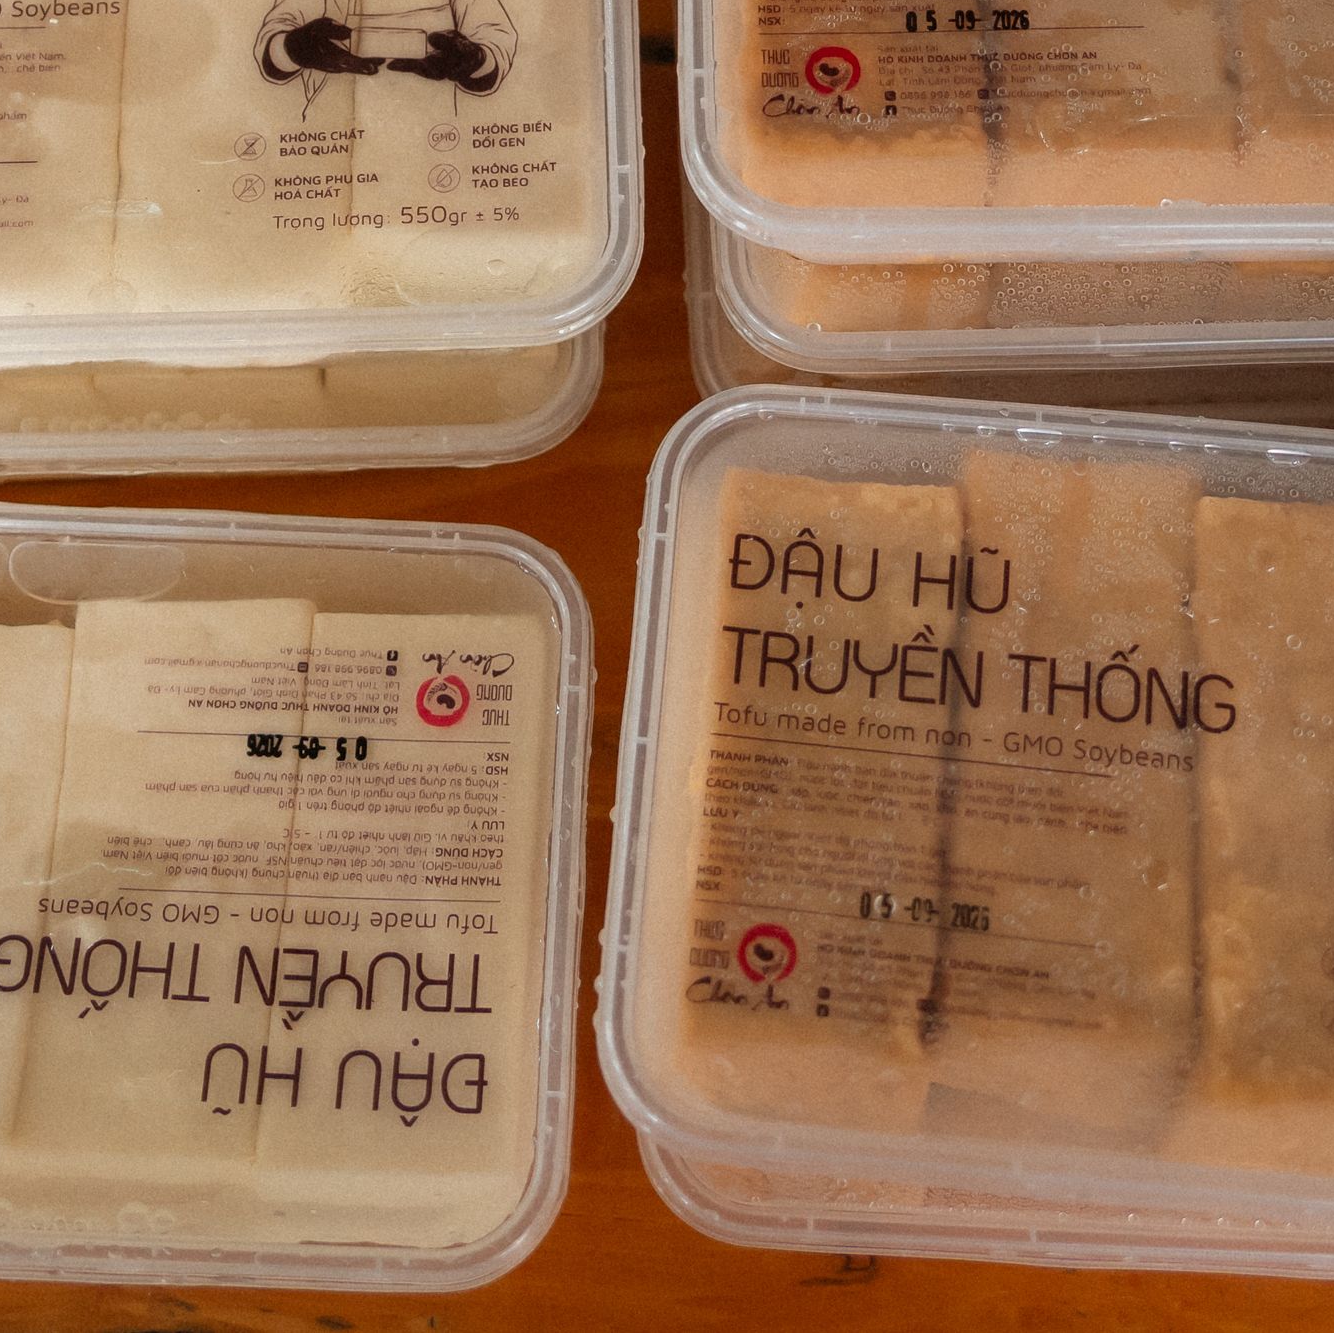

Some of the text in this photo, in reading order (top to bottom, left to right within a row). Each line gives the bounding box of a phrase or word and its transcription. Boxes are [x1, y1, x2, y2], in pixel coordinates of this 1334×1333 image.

[279, 128, 366, 144] KHÔNG CHẤT
[472, 119, 552, 135] KHÔNG BIẾN
[498, 137, 526, 148] GEN
[471, 159, 557, 175] KHÔNG CHẤT
[274, 173, 322, 187] KHÔNG
[356, 172, 380, 184] GIA
[305, 186, 342, 199] CHẤT
[272, 215, 326, 232] Trọng
[400, 206, 467, 229] 550gr
[492, 206, 520, 223] 5%
[728, 527, 1012, 614] ĐẬU HŨ
[722, 623, 1238, 734] TRUYỀN THỐNG
[714, 701, 768, 727] Tofu
[777, 712, 846, 735] made
[857, 715, 916, 743] from
[925, 726, 972, 748] non
[1003, 730, 1065, 758] GMO
[1073, 738, 1195, 772] Soybeans
[37, 895, 154, 923] Soybeans
[161, 902, 221, 925] GMO
[250, 906, 295, 925] non
[304, 909, 361, 932] from
[369, 910, 437, 933] made
[445, 912, 499, 935] Tofu
[234, 945, 493, 1031] TRUYỀN
[200, 1037, 489, 1129] ĐẬU HŨ
